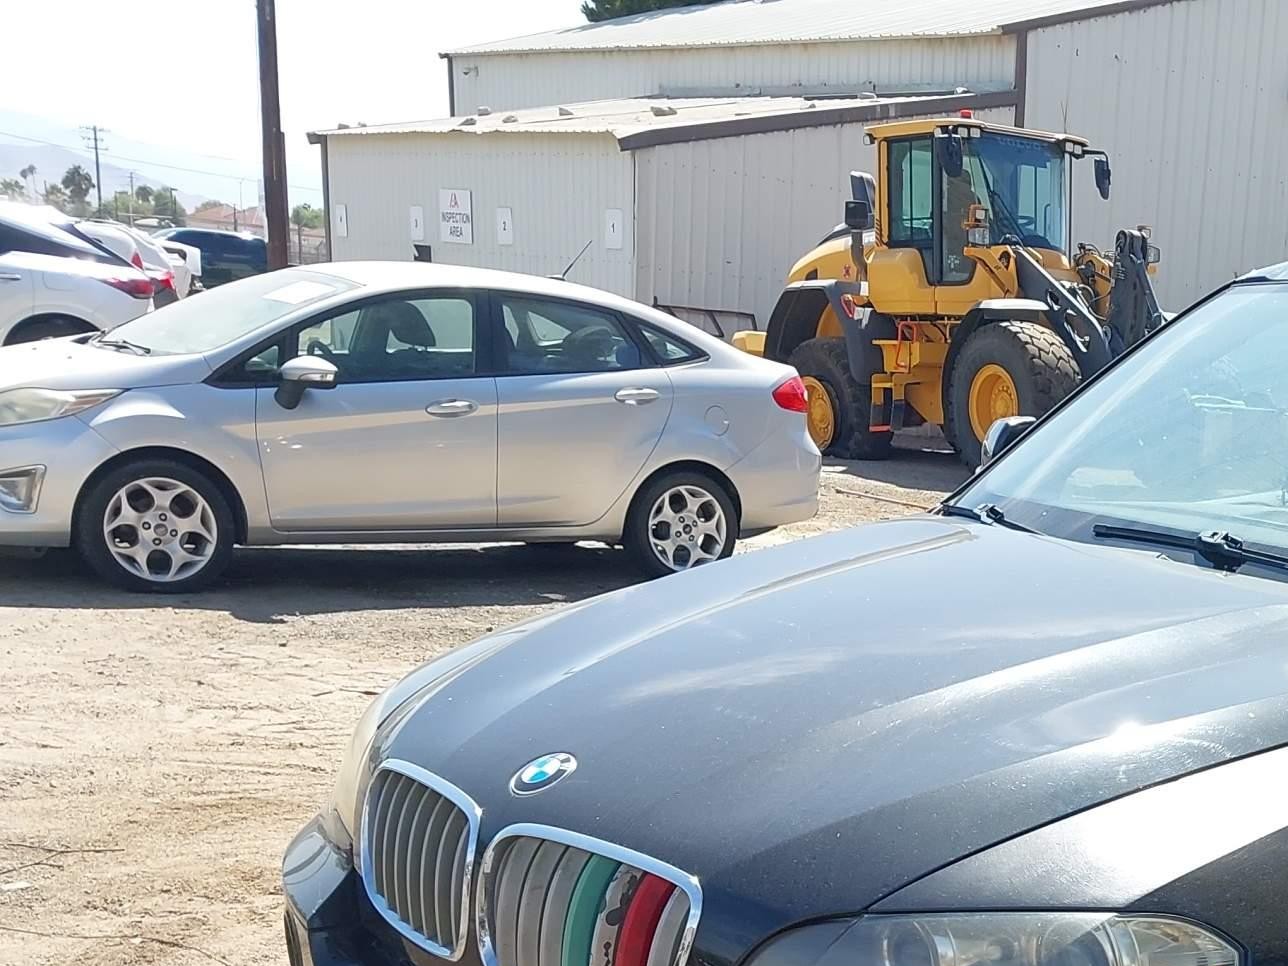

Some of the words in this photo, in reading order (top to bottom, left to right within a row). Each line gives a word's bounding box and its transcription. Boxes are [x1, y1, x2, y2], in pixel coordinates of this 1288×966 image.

[441, 211, 471, 224] INSPECTION
[449, 225, 463, 237] AREA
[502, 221, 507, 231] 2
